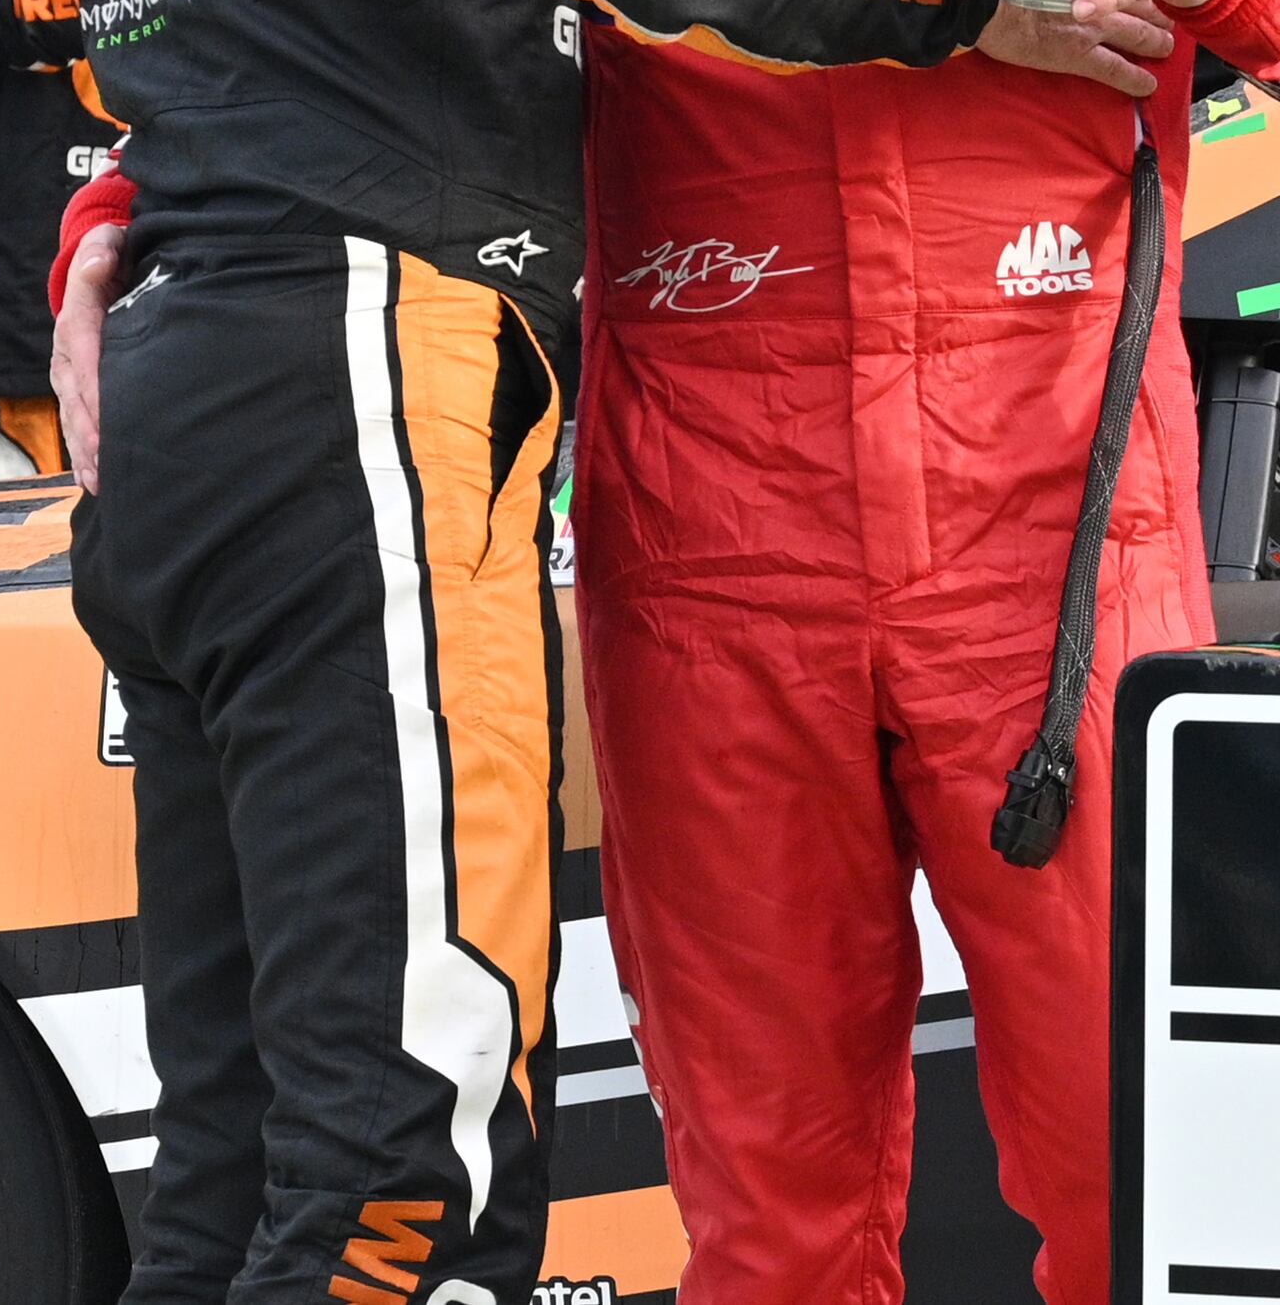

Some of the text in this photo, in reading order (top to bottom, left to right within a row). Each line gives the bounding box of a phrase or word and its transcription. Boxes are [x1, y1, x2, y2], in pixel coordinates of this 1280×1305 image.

[96, 15, 166, 50] ENERGY
[996, 221, 1092, 278] MAC
[996, 274, 1093, 297] TOOLS
